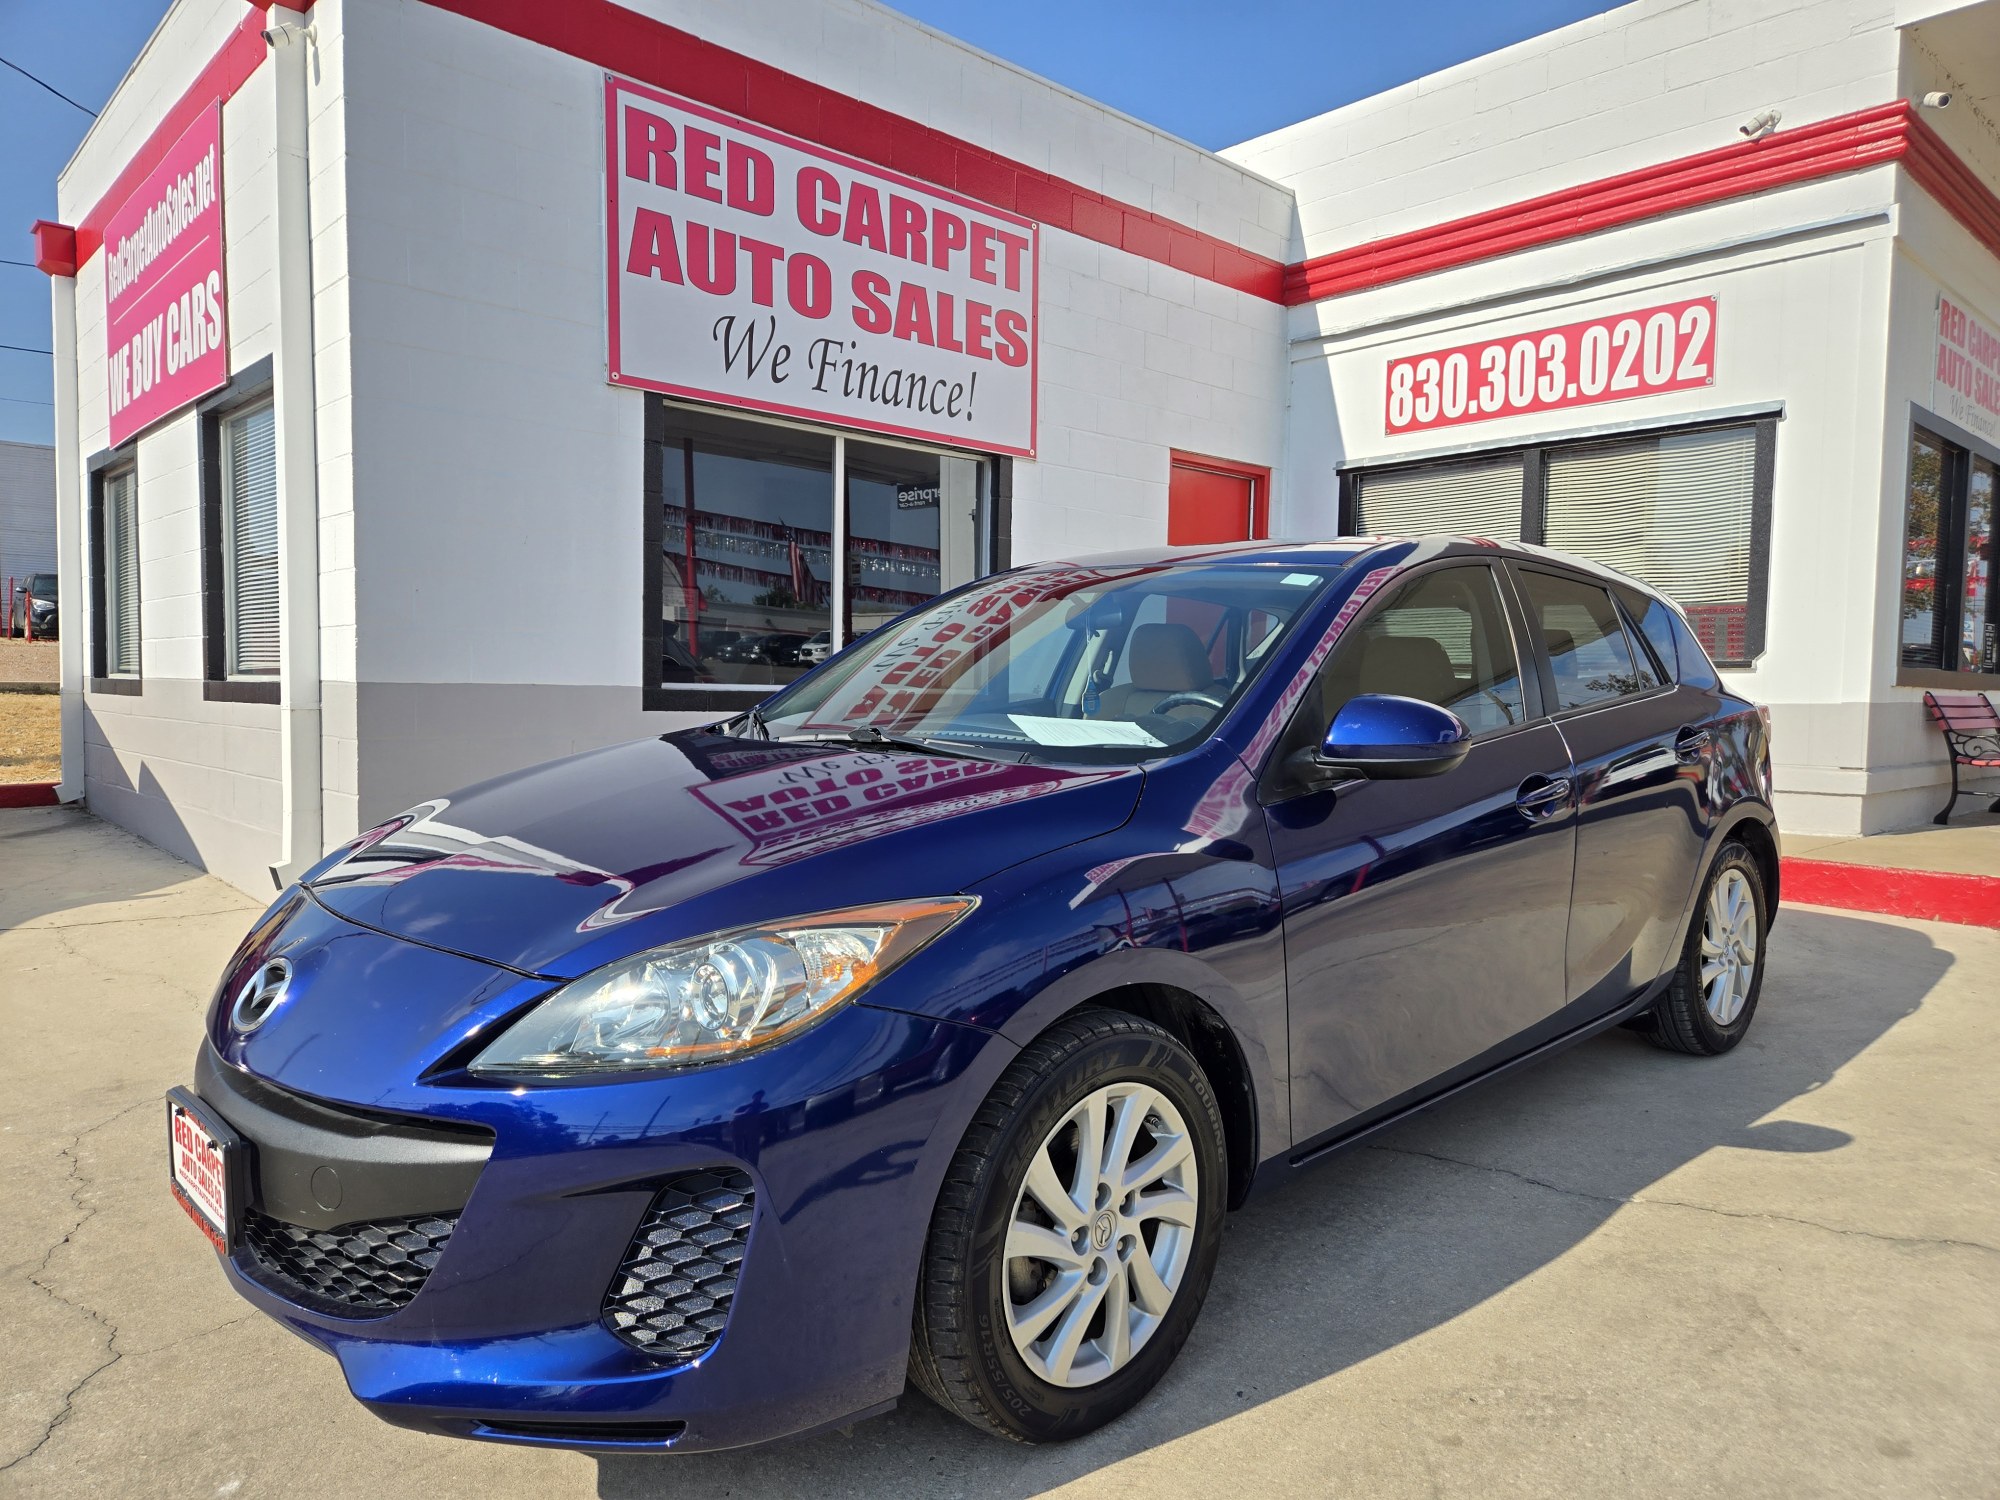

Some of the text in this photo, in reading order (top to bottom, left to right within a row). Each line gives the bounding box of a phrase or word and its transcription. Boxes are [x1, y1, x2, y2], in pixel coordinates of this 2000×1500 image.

[108, 143, 215, 303] RedCarpetAutoSales.net
[624, 104, 1029, 292] RED CARPET
[626, 207, 1028, 367] AUTO SALES
[1940, 298, 1966, 349] RED
[109, 269, 221, 417] WE BUY CARS
[713, 315, 977, 421] We Finance!
[1389, 305, 1711, 427] 830.303.0202
[1936, 344, 1973, 398] AUTO
[174, 1116, 193, 1154] RED
[1187, 1068, 1224, 1164] TOURING
[182, 1150, 197, 1180] AUTO
[197, 1165, 214, 1198] SALES
[978, 1313, 1032, 1417] 205/55R16
